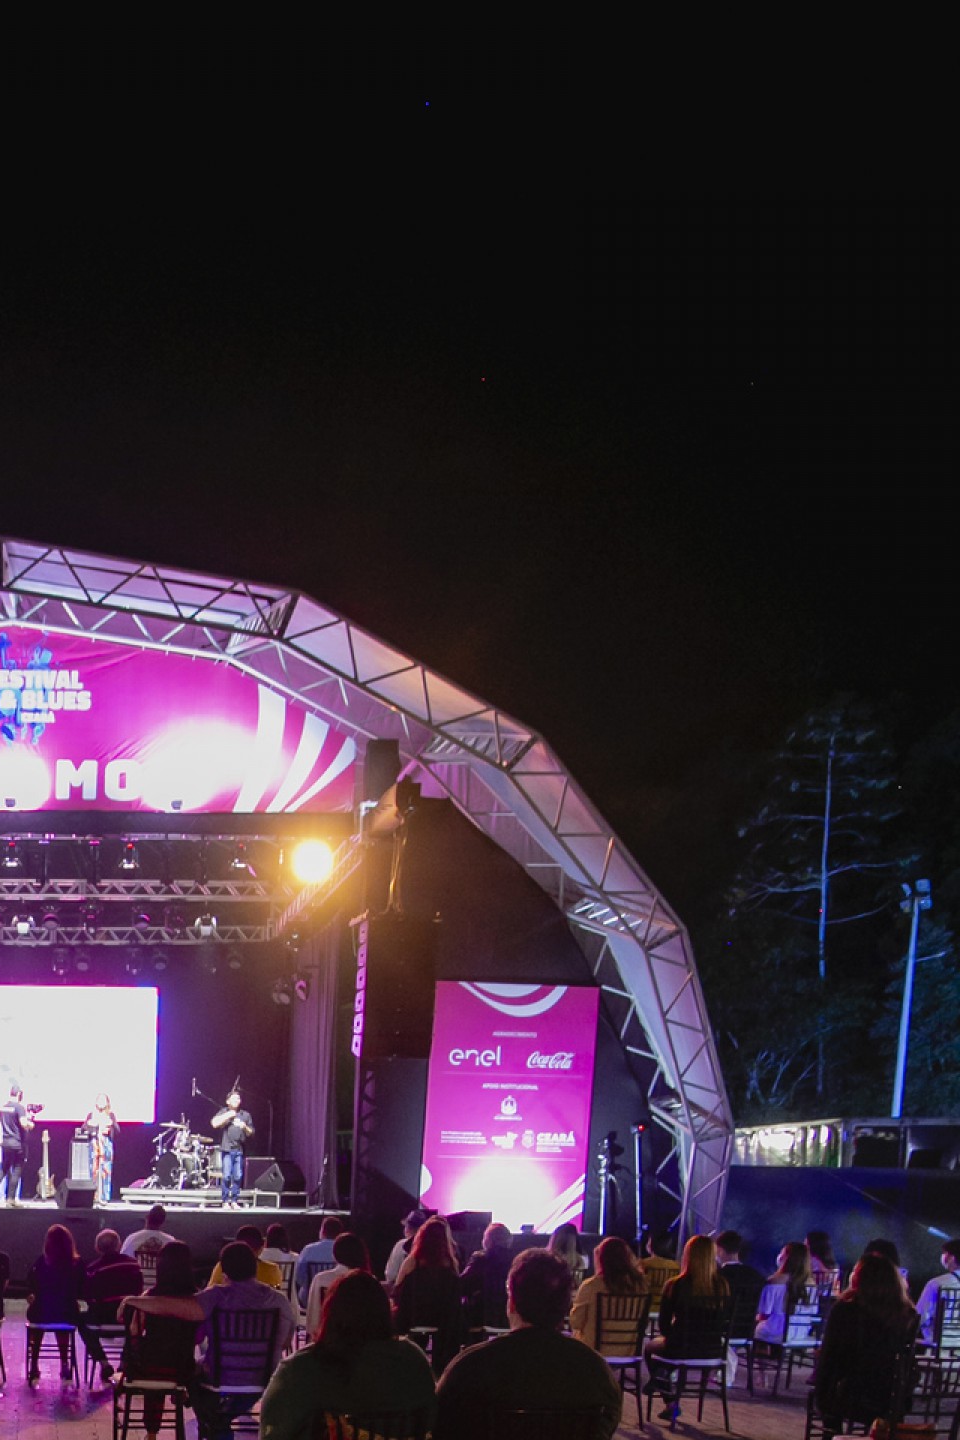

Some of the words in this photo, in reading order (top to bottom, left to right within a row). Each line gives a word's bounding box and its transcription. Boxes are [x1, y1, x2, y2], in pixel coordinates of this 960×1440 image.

[0, 689, 17, 709] &
[21, 690, 92, 711] BLUES
[449, 1045, 502, 1067] enel
